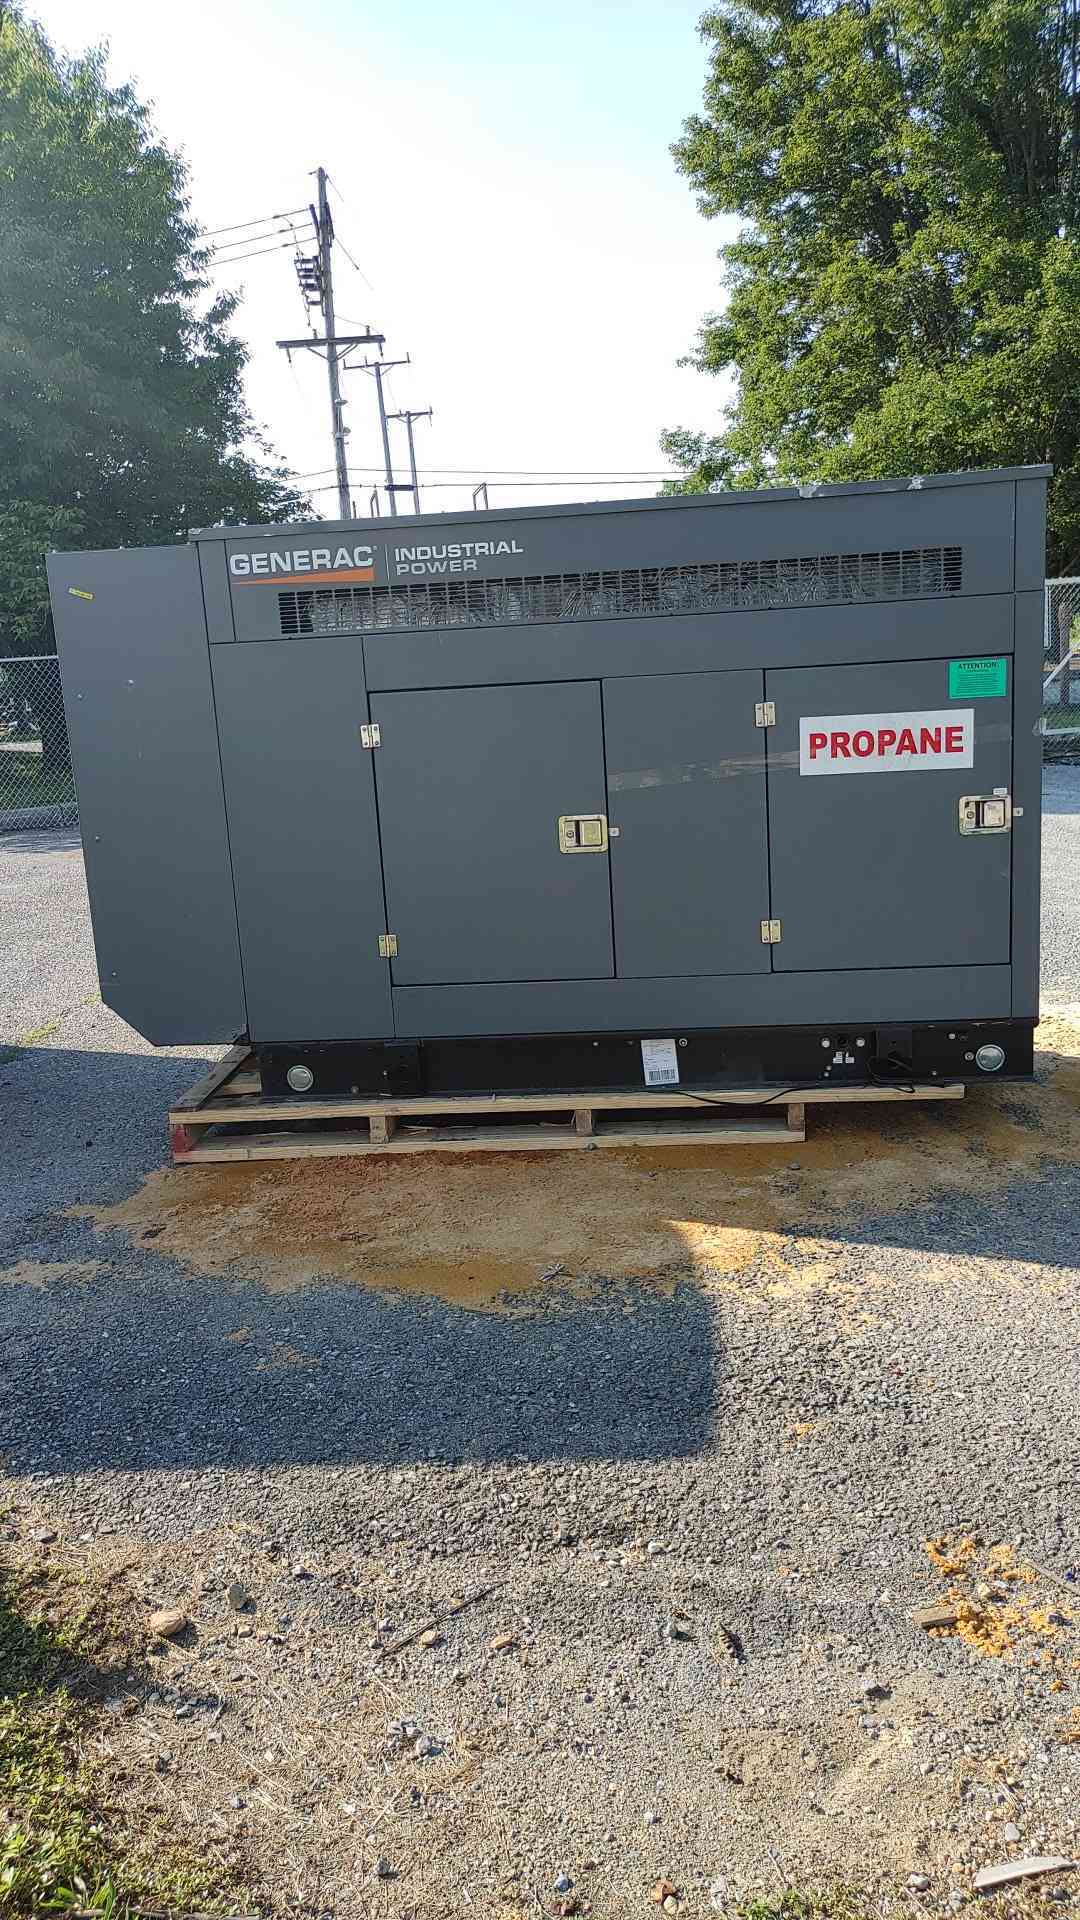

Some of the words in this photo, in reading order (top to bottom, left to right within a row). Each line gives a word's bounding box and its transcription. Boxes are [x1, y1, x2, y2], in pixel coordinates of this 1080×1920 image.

[230, 545, 374, 575] GENERAC
[395, 540, 524, 561] INDUSTRIAL
[396, 559, 478, 576] POWER
[809, 726, 964, 760] PROPANE
